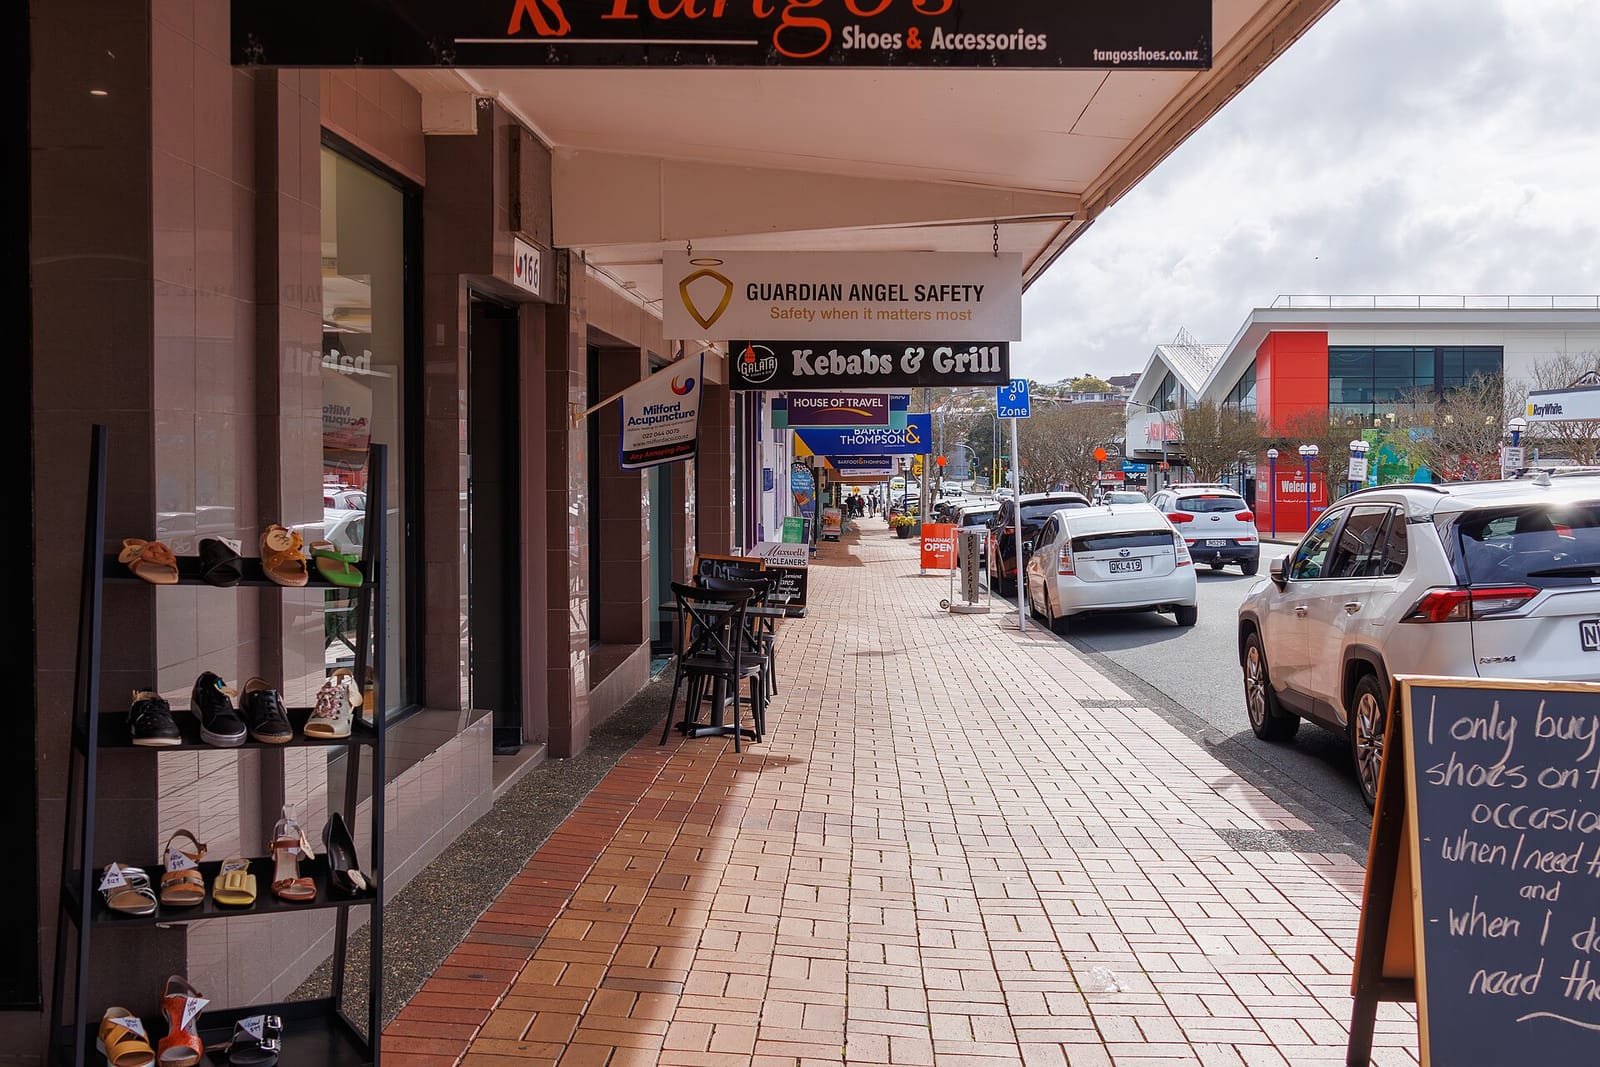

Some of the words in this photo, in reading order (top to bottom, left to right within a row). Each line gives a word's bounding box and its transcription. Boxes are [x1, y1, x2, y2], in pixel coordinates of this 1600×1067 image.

[842, 25, 903, 50] Shoes
[906, 26, 922, 50] &
[930, 27, 1048, 51] Accessories
[1093, 46, 1199, 63] tangosshoes.co.nz
[524, 253, 539, 288] 166
[746, 283, 843, 302] GUARDIAN
[848, 284, 910, 302] ANGEL
[914, 284, 985, 302] SAFETY
[769, 306, 816, 323] Safety
[820, 307, 859, 320] when
[863, 308, 873, 320] it
[876, 308, 932, 321] matters
[936, 309, 972, 321] most
[741, 357, 775, 377] GALATA
[791, 346, 893, 377] Kebabs
[900, 347, 926, 374] &
[932, 345, 1001, 374] Grill
[643, 402, 681, 416] Milford
[793, 399, 829, 408] HOUSE
[830, 399, 845, 408] OF
[846, 398, 884, 408] TRAVEL
[1000, 406, 1028, 416] Zone
[627, 410, 696, 426] Acupuncture
[840, 434, 906, 445] THOMPSON
[906, 424, 921, 444] &
[760, 545, 806, 557] Maxwells
[924, 542, 954, 552] OPEN
[762, 558, 807, 567] RYCLEANERS
[1450, 700, 1518, 769] only
[1535, 699, 1600, 762] buy
[1425, 752, 1528, 789] shoes
[1537, 766, 1580, 789] on
[1442, 828, 1507, 865] when
[1522, 842, 1584, 874] need
[1519, 880, 1561, 902] and
[1449, 895, 1521, 938] when
[1468, 957, 1545, 996] need
